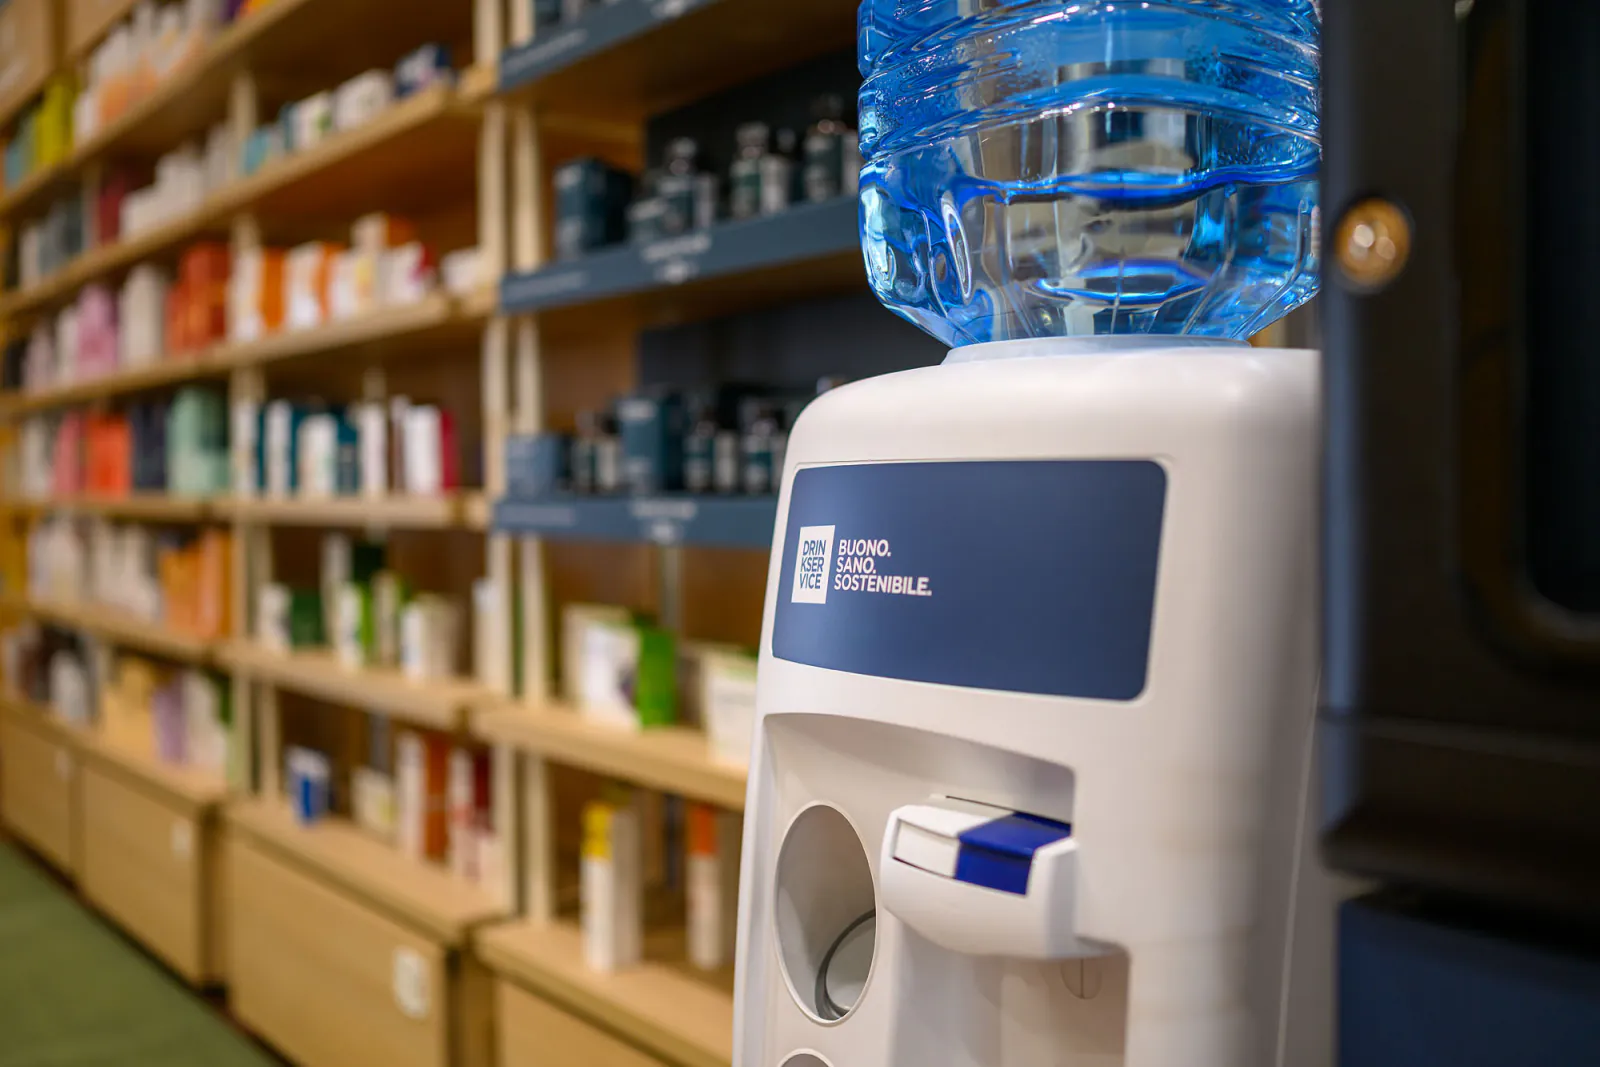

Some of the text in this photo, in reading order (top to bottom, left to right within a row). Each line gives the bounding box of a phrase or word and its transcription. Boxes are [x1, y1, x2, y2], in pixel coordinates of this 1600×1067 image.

[803, 540, 827, 556] DRIN
[838, 539, 892, 557] BUONO.
[800, 557, 825, 573] KSER
[836, 557, 876, 574] SANO.
[799, 573, 821, 589] VICE
[834, 574, 932, 596] SOSTENIBILE.
